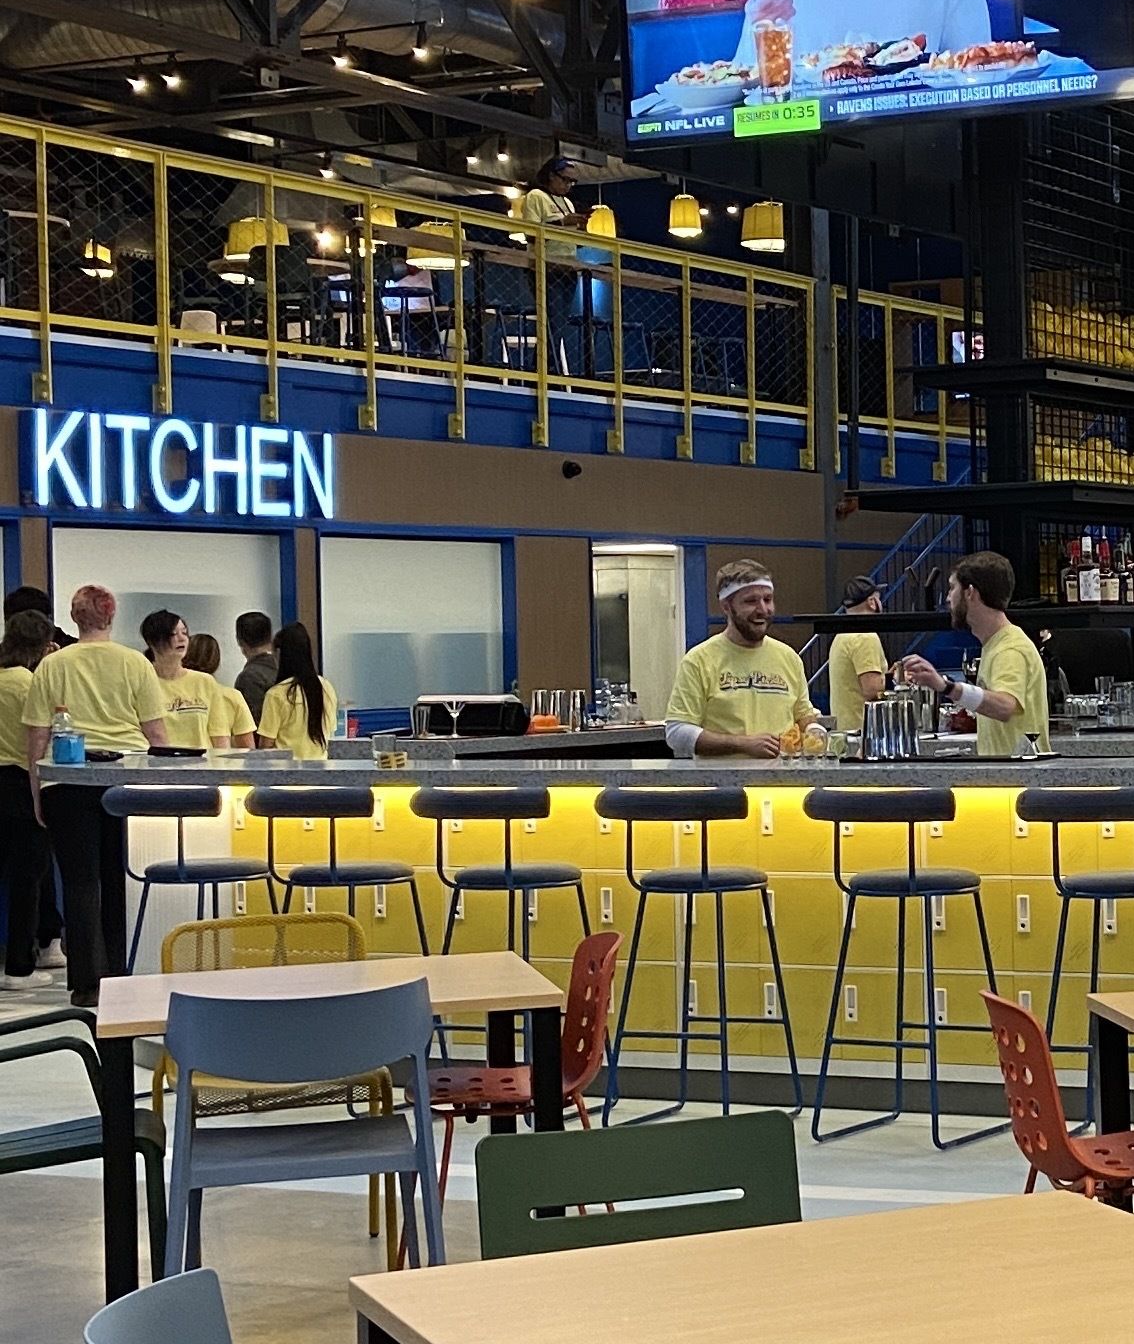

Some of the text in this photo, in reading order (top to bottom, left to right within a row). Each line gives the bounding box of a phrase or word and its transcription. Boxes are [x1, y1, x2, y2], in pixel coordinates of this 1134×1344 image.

[837, 98, 872, 115] RAVENS
[909, 89, 959, 107] EXECUTION
[961, 86, 991, 102] BASED
[1006, 78, 1060, 97] PERSONNEL
[1061, 75, 1098, 91] NEEDS?
[638, 115, 725, 134] ESPN NFL LIVE
[737, 110, 771, 124] RESUMES
[783, 105, 815, 119] 0:35
[34, 408, 334, 519] KITCHEN
